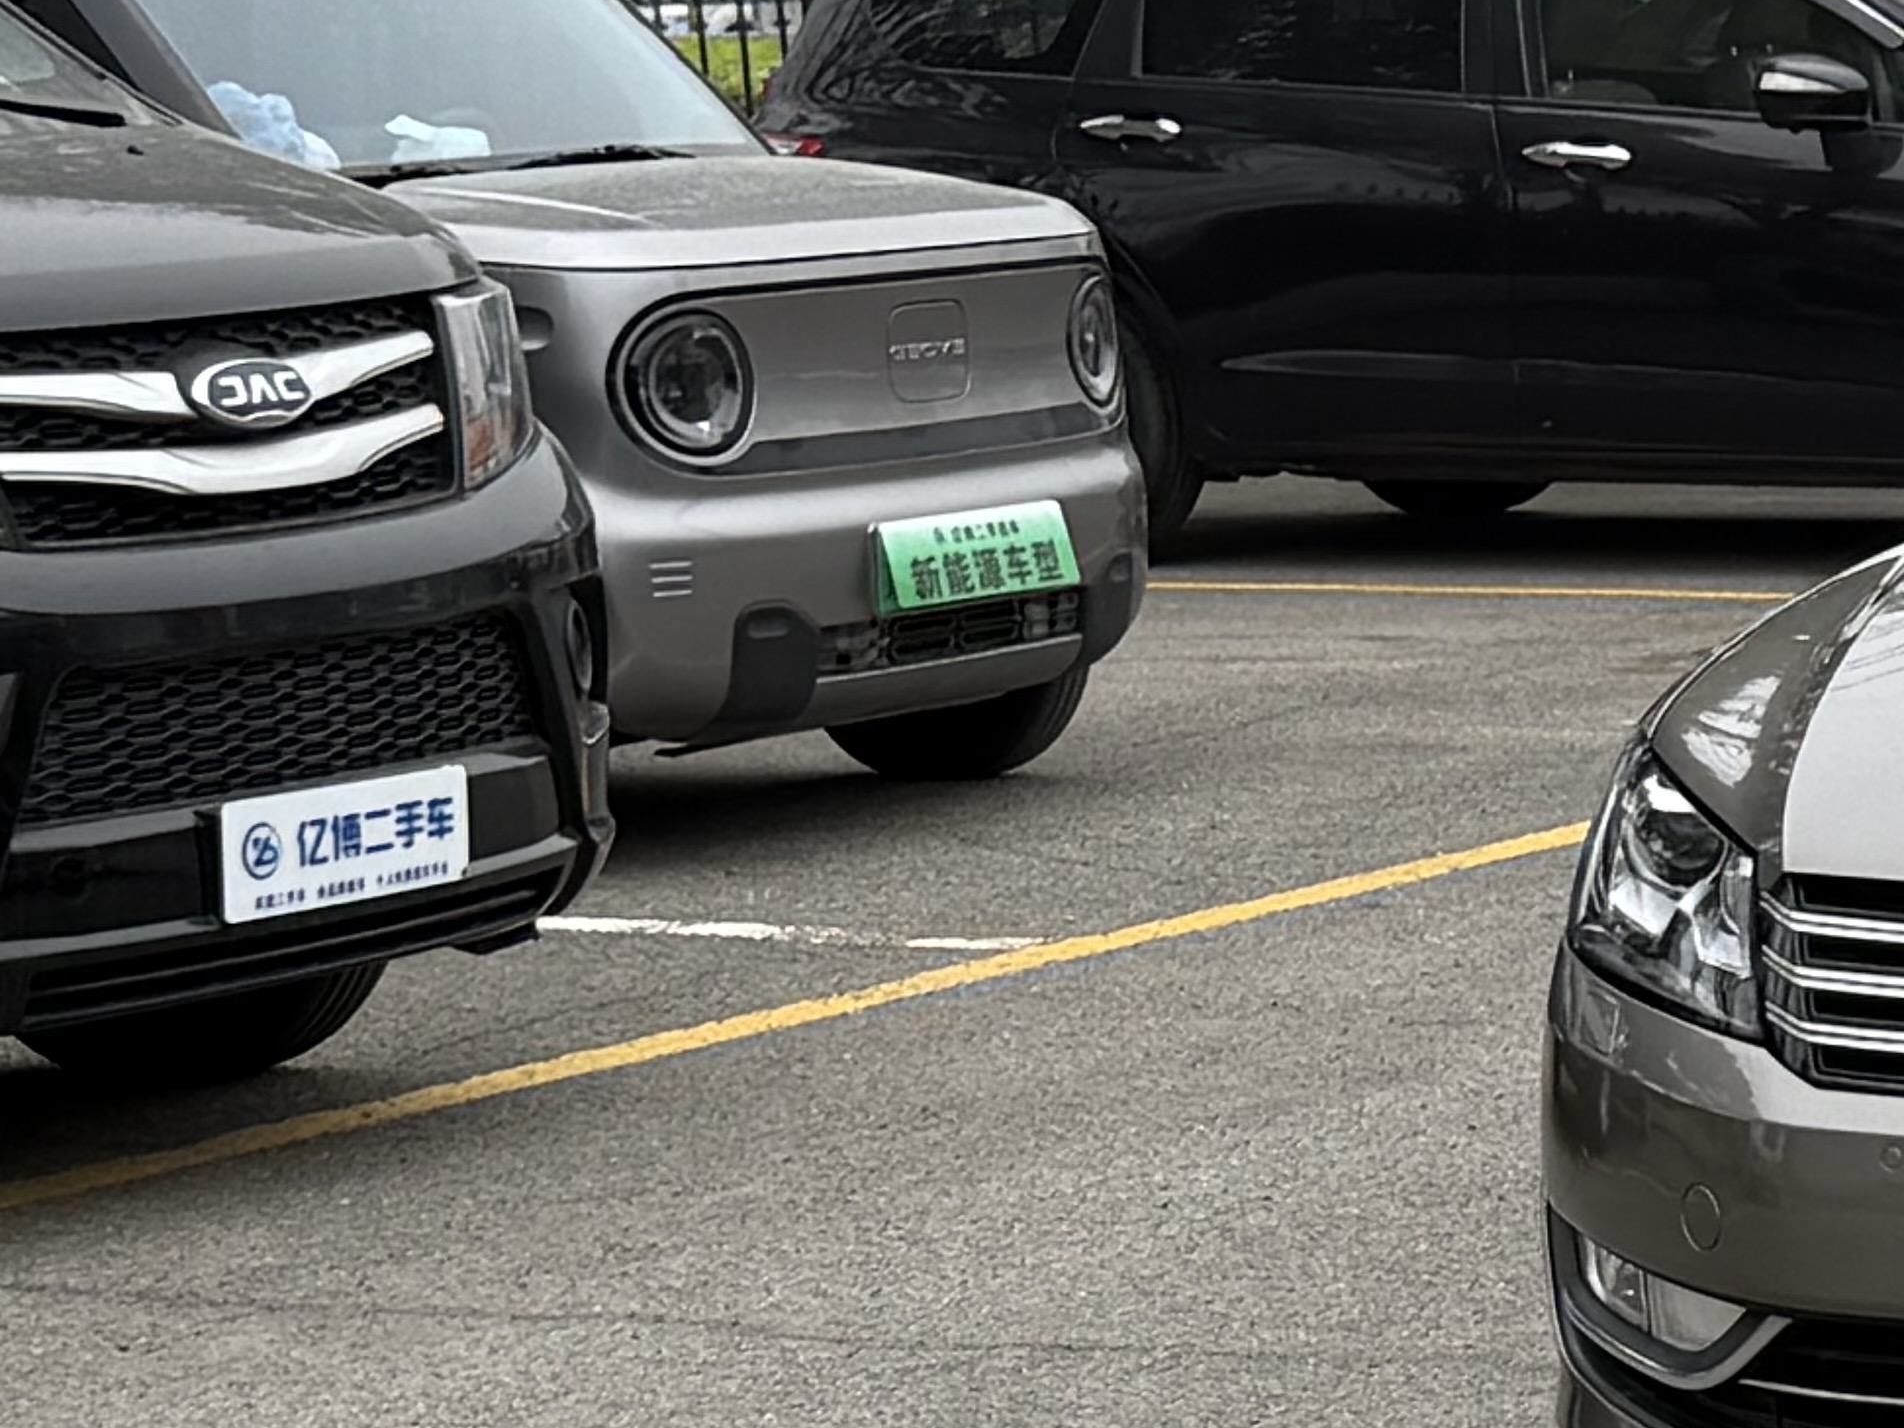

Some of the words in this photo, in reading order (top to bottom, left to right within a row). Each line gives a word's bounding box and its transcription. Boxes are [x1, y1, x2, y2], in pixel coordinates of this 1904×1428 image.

[217, 371, 306, 407] JAC
[911, 538, 1065, 600] 新能源车型
[297, 796, 454, 868] 亿博二手车
